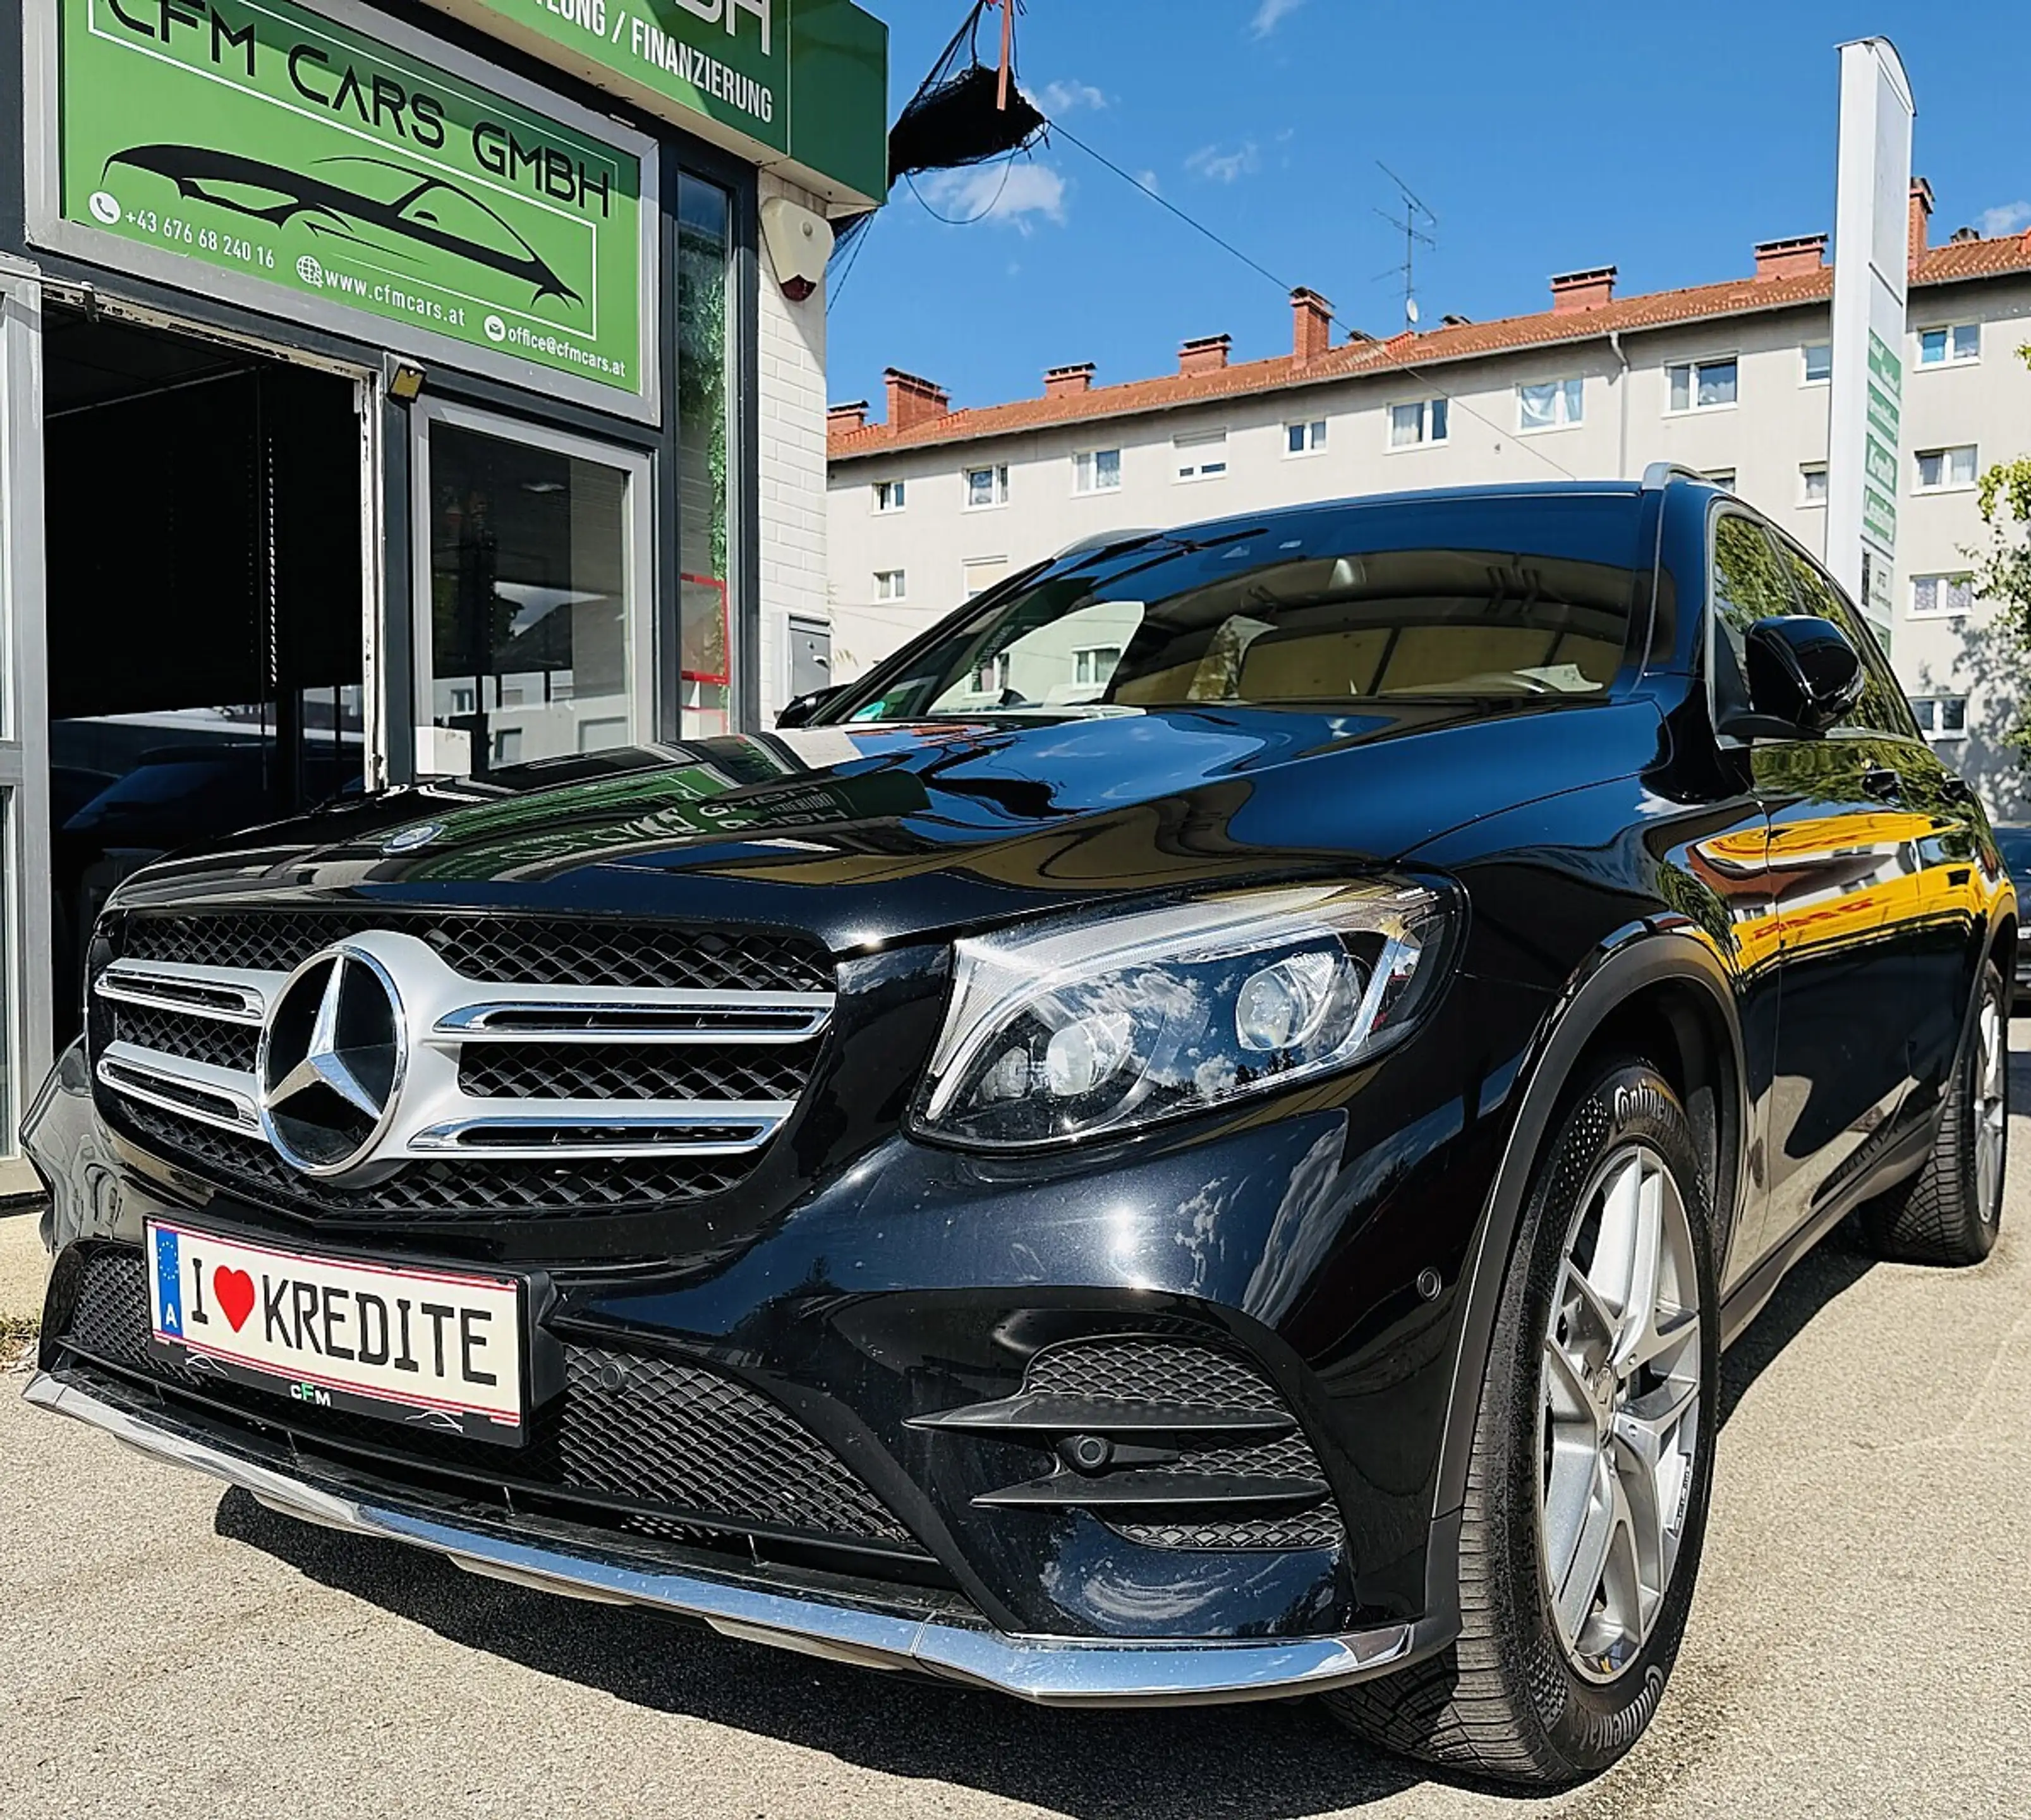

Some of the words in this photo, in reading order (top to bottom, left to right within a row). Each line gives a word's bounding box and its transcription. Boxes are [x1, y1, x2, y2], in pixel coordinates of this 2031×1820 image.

[631, 16, 773, 123] FINANZIERUNG
[288, 44, 444, 149] CARS
[473, 121, 609, 218] GMBH
[125, 209, 157, 233] +43
[164, 218, 193, 243] 676
[198, 228, 218, 251] 68
[223, 236, 251, 261] 240
[257, 246, 274, 269] 16
[325, 268, 465, 327] www.cfmcars.at
[508, 328, 626, 378] office@cfmcars.at
[166, 1303, 178, 1328] A
[191, 1258, 209, 1325] I
[262, 1274, 497, 1386] KREDITE
[1579, 1665, 1664, 1754] Continental
